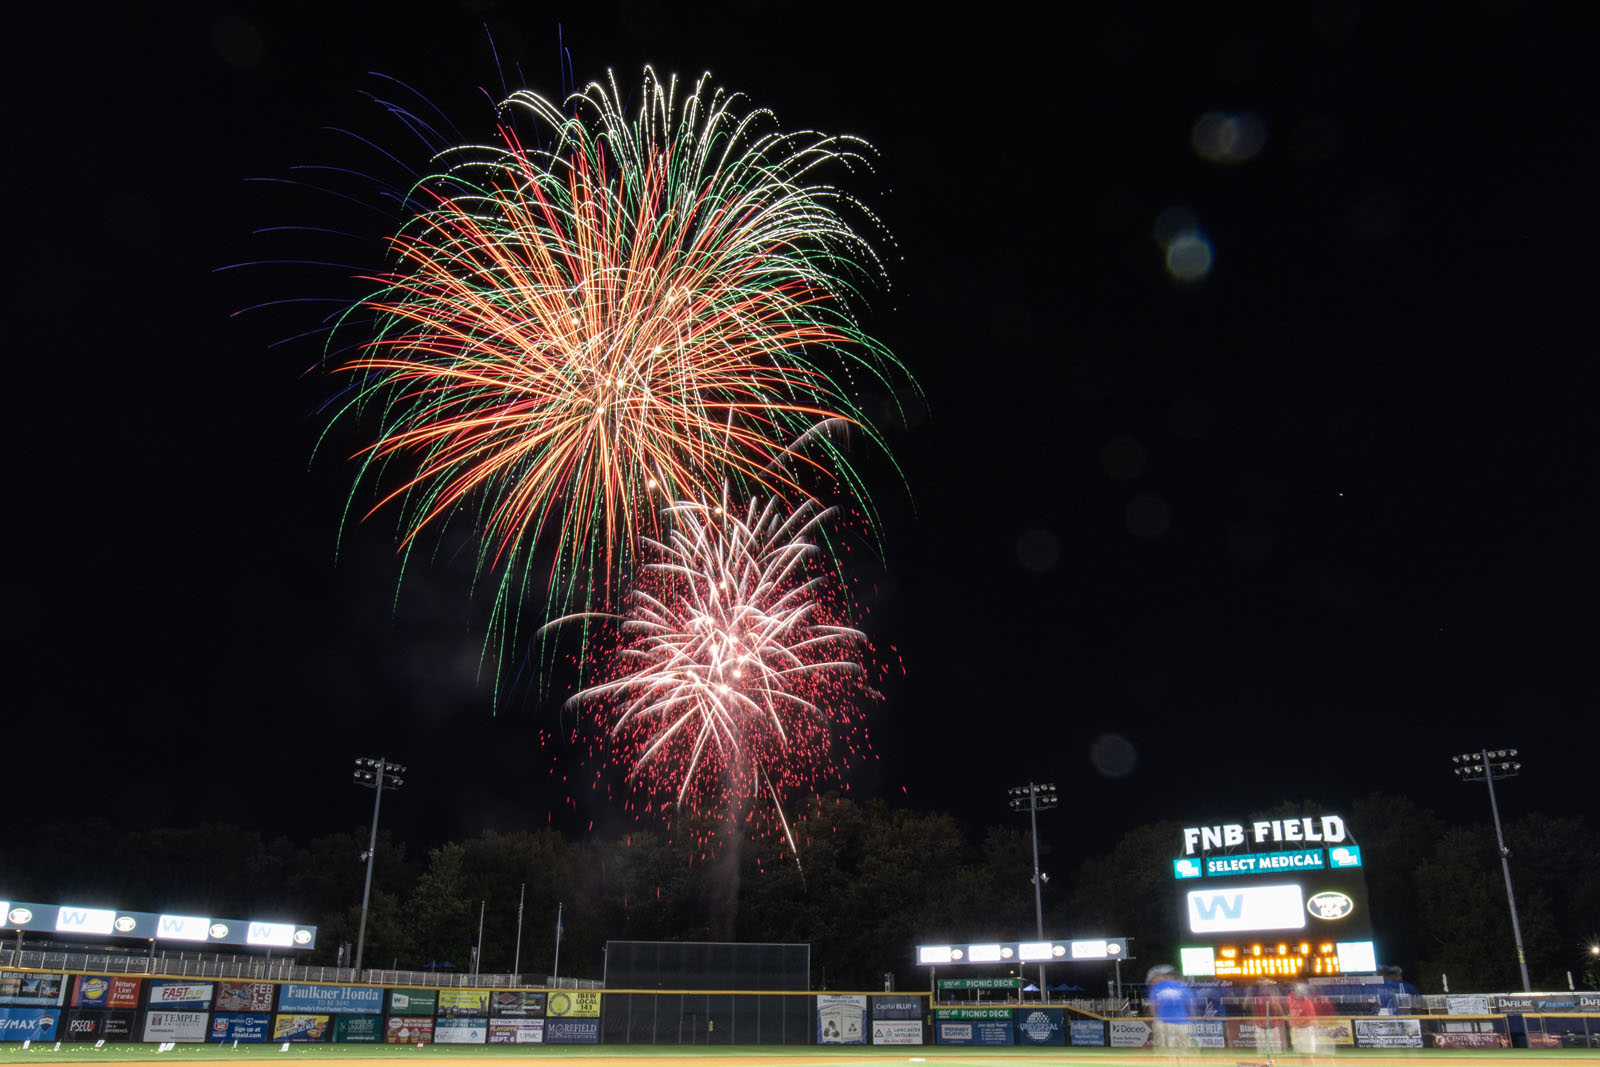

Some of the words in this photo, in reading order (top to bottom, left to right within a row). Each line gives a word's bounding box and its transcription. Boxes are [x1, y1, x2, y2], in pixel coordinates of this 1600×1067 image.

[1184, 824, 1244, 855] FNB
[1253, 815, 1346, 843] FIELD
[1208, 858, 1256, 873] SELECT
[1259, 854, 1322, 869] MEDICAL
[115, 981, 136, 989] Nittany
[253, 983, 274, 994] FEB
[993, 979, 1014, 987] DECK
[162, 987, 189, 998] FAST
[287, 984, 340, 999] Faulkner
[341, 987, 379, 1000] Honda
[252, 993, 272, 1004] 1-9
[250, 1003, 271, 1011] 2020
[163, 1013, 200, 1022] TEMPLE
[961, 1010, 988, 1018] PICNIC
[988, 1009, 1009, 1017] DECK
[70, 1020, 94, 1032] PSECU
[548, 1023, 597, 1034] MOREFIELD
[1019, 1022, 1059, 1032] UNIVERSAL
[1121, 1024, 1146, 1033] Doceo
[1206, 1022, 1221, 1034] HELP
